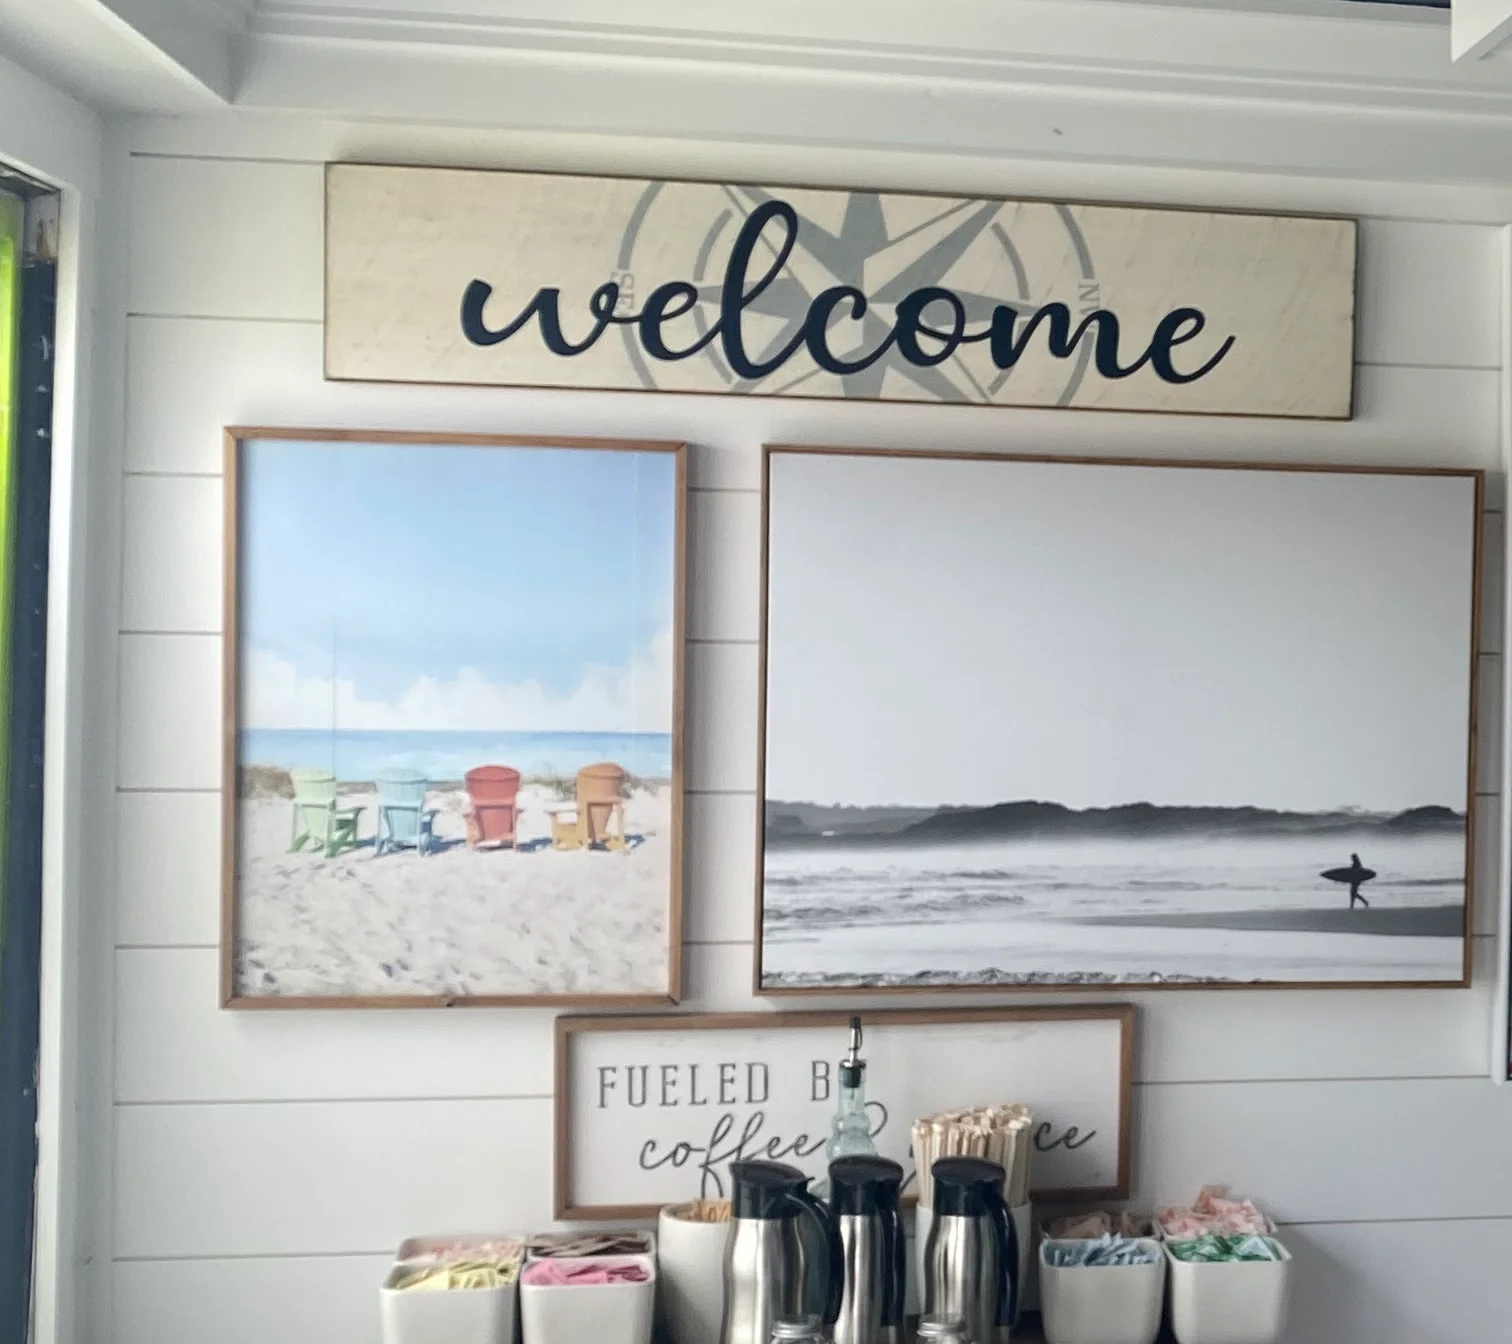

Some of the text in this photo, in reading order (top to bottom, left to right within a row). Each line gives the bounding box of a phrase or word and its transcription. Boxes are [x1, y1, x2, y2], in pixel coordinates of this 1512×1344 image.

[460, 198, 1238, 386] welcome
[596, 1060, 770, 1109] FUELED
[638, 1111, 828, 1198] coffee
